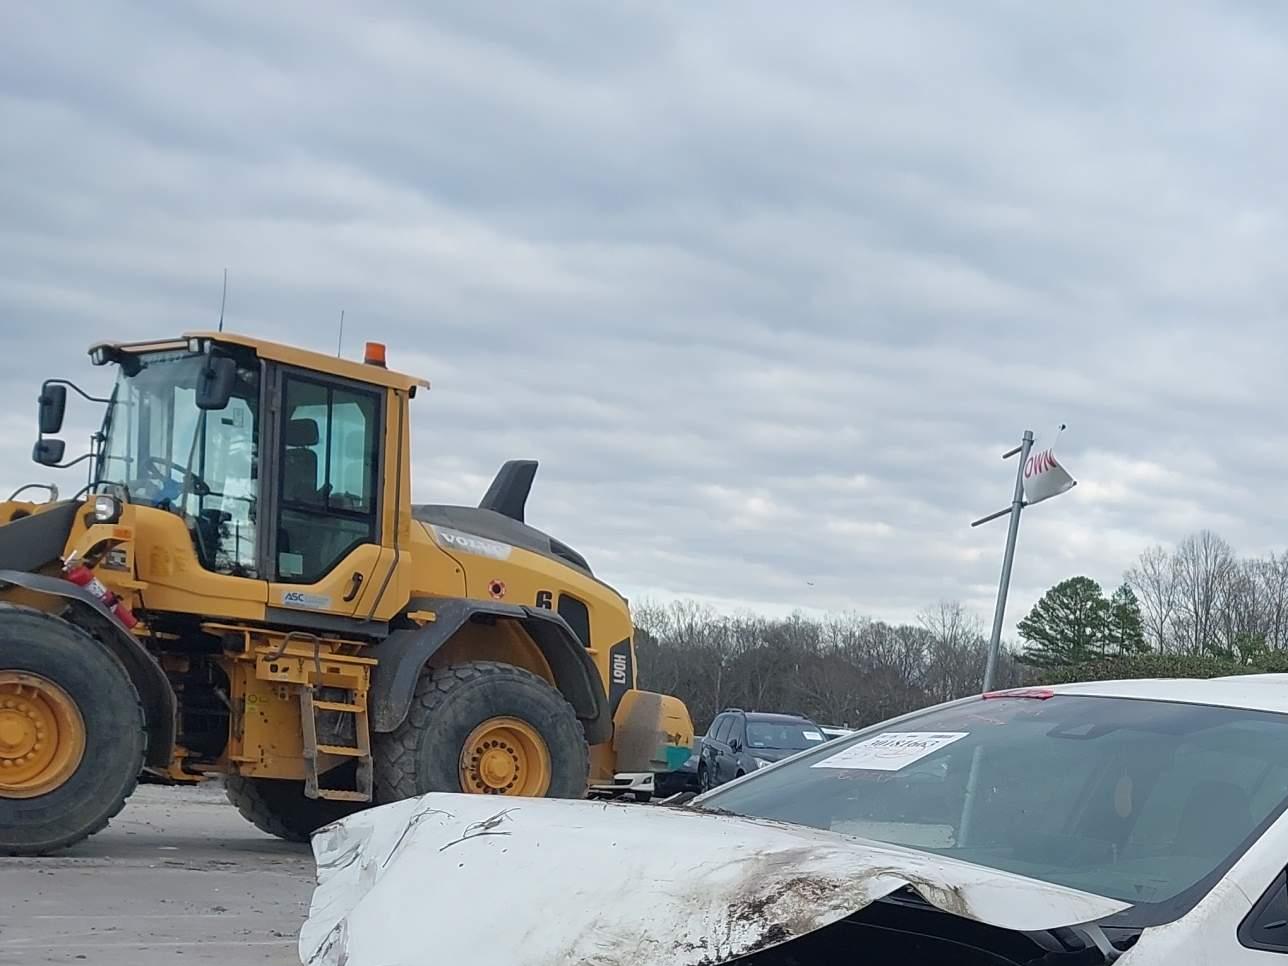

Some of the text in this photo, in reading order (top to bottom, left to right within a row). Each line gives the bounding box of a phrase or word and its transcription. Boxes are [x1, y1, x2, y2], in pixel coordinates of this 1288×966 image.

[284, 592, 304, 602] ASC
[535, 590, 553, 610] 6
[613, 653, 627, 685] L90H
